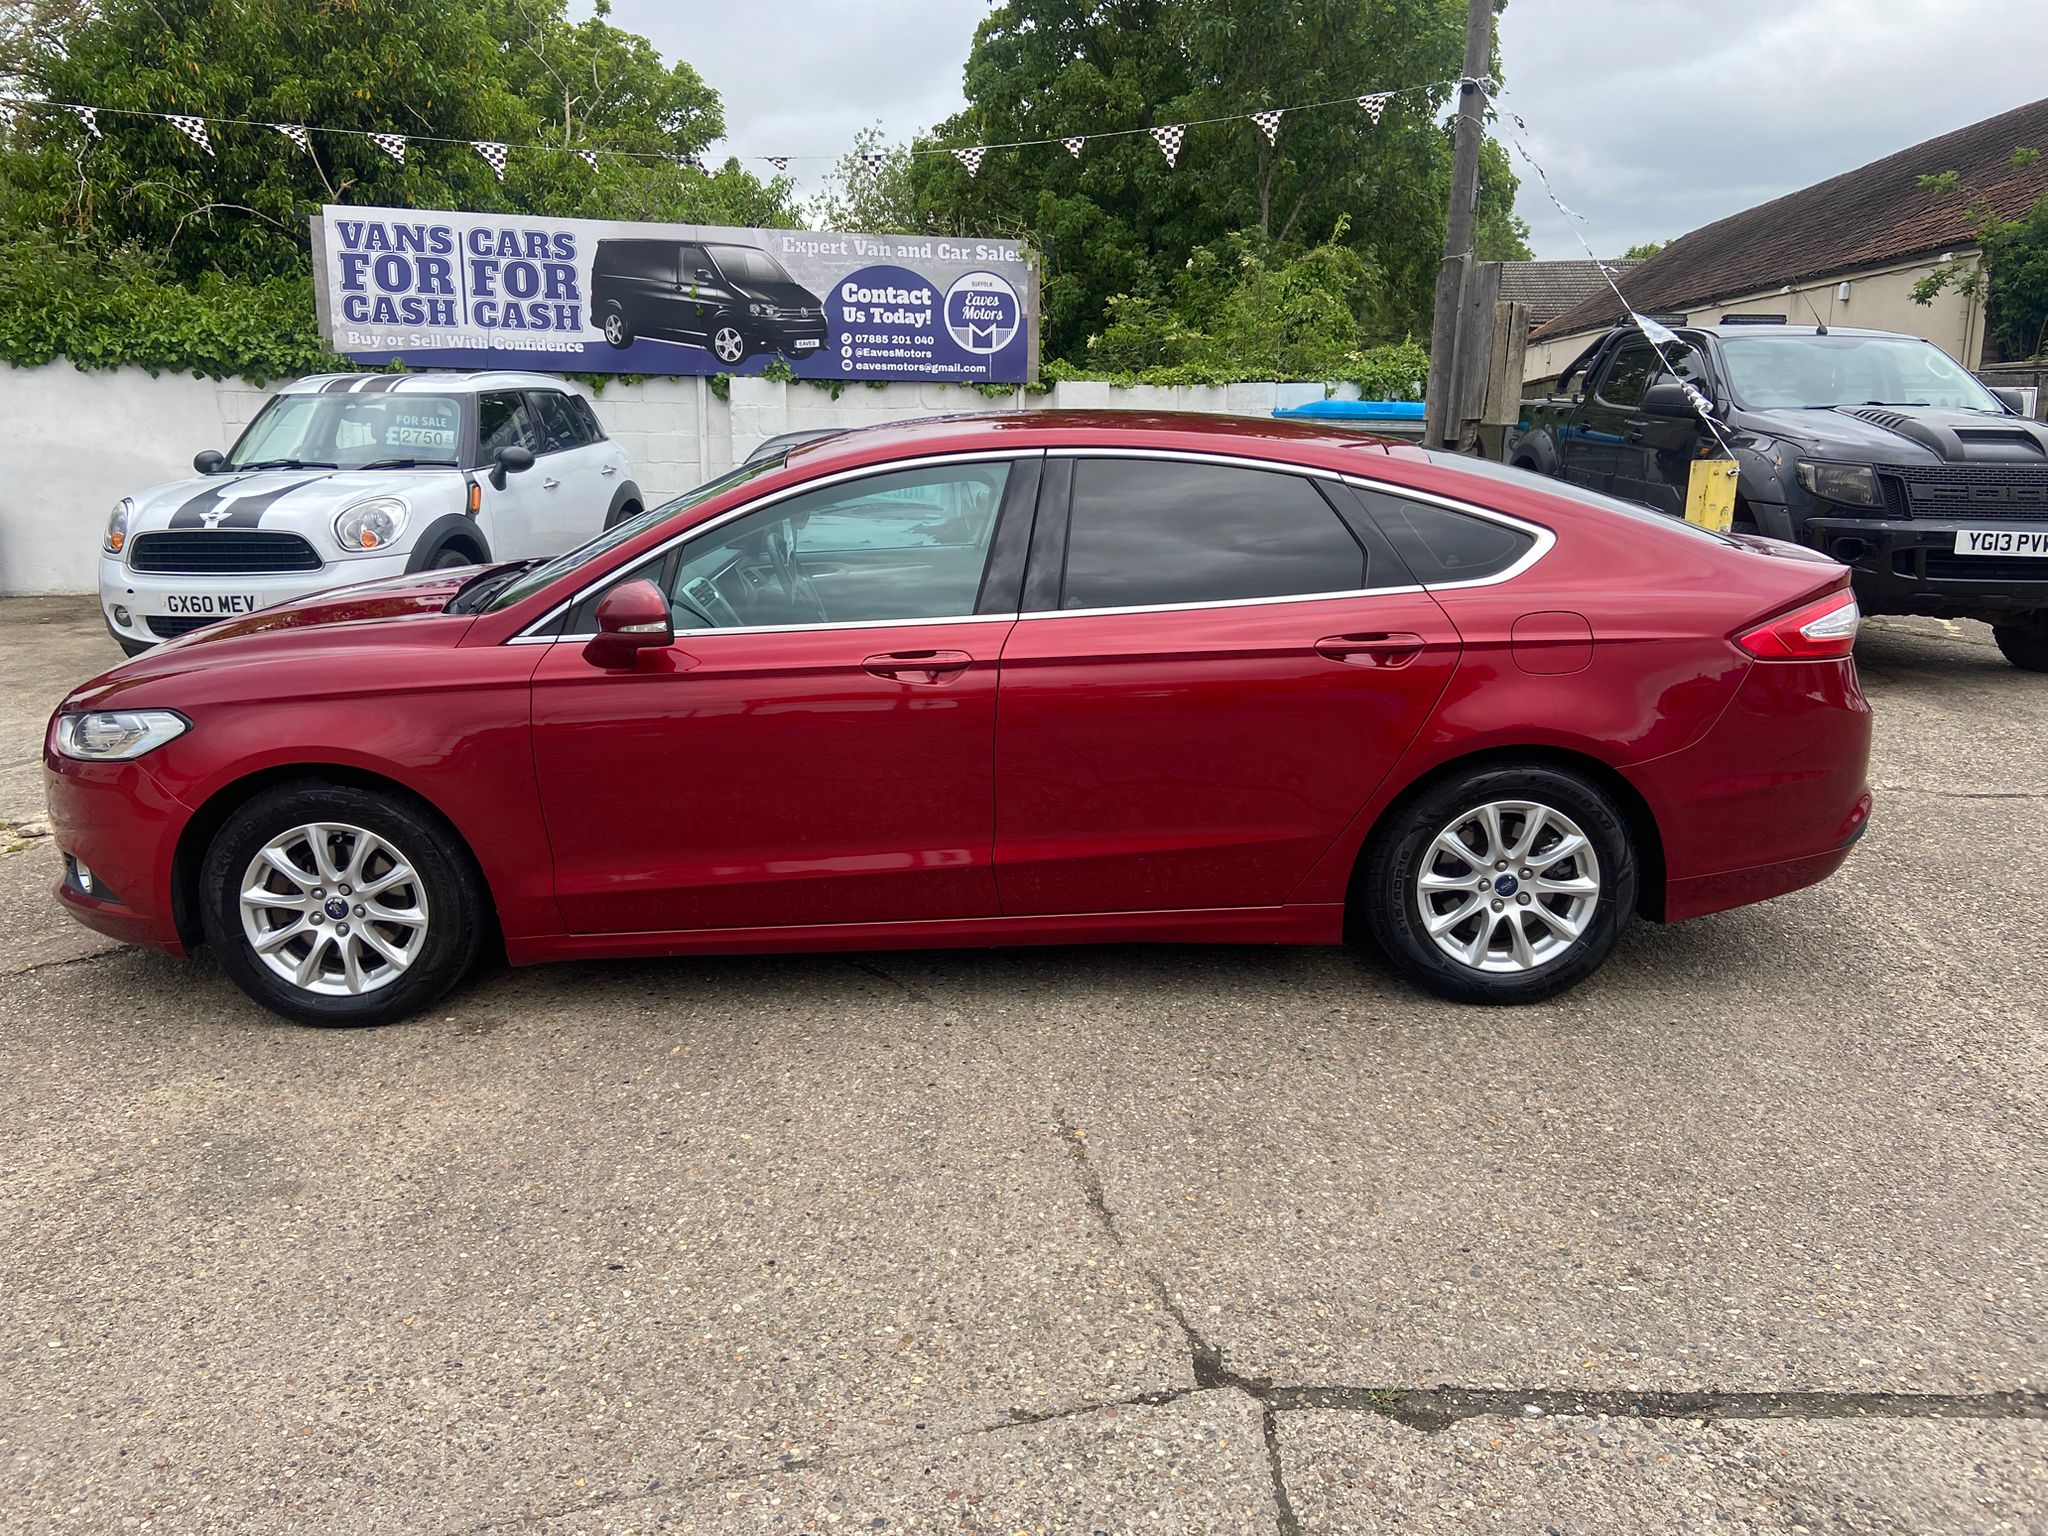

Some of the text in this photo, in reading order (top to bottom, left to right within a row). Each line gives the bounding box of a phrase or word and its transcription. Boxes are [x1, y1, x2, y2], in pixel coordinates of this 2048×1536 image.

[335, 220, 454, 254] VANS
[468, 227, 577, 261] CARS
[782, 236, 1024, 262] Expert Van and Car Sales
[339, 252, 456, 296] FOR
[470, 259, 580, 300] FOR
[841, 283, 931, 305] Contact
[965, 292, 999, 306] Eaves
[341, 294, 457, 327] CASH
[471, 300, 583, 332] CASH
[843, 306, 932, 328] Us Today!
[962, 305, 1004, 320] Motors
[347, 331, 584, 352] Buy or Sell With Confidence
[855, 334, 934, 345] 07885 201 040
[855, 348, 932, 358] @EavesMotors
[855, 363, 986, 373] eavesmotors@gmail.com
[396, 415, 447, 427] FOR SALE
[385, 426, 443, 445] £2750
[1969, 533, 2012, 551] YG13
[168, 595, 254, 612] GX60 MEV
